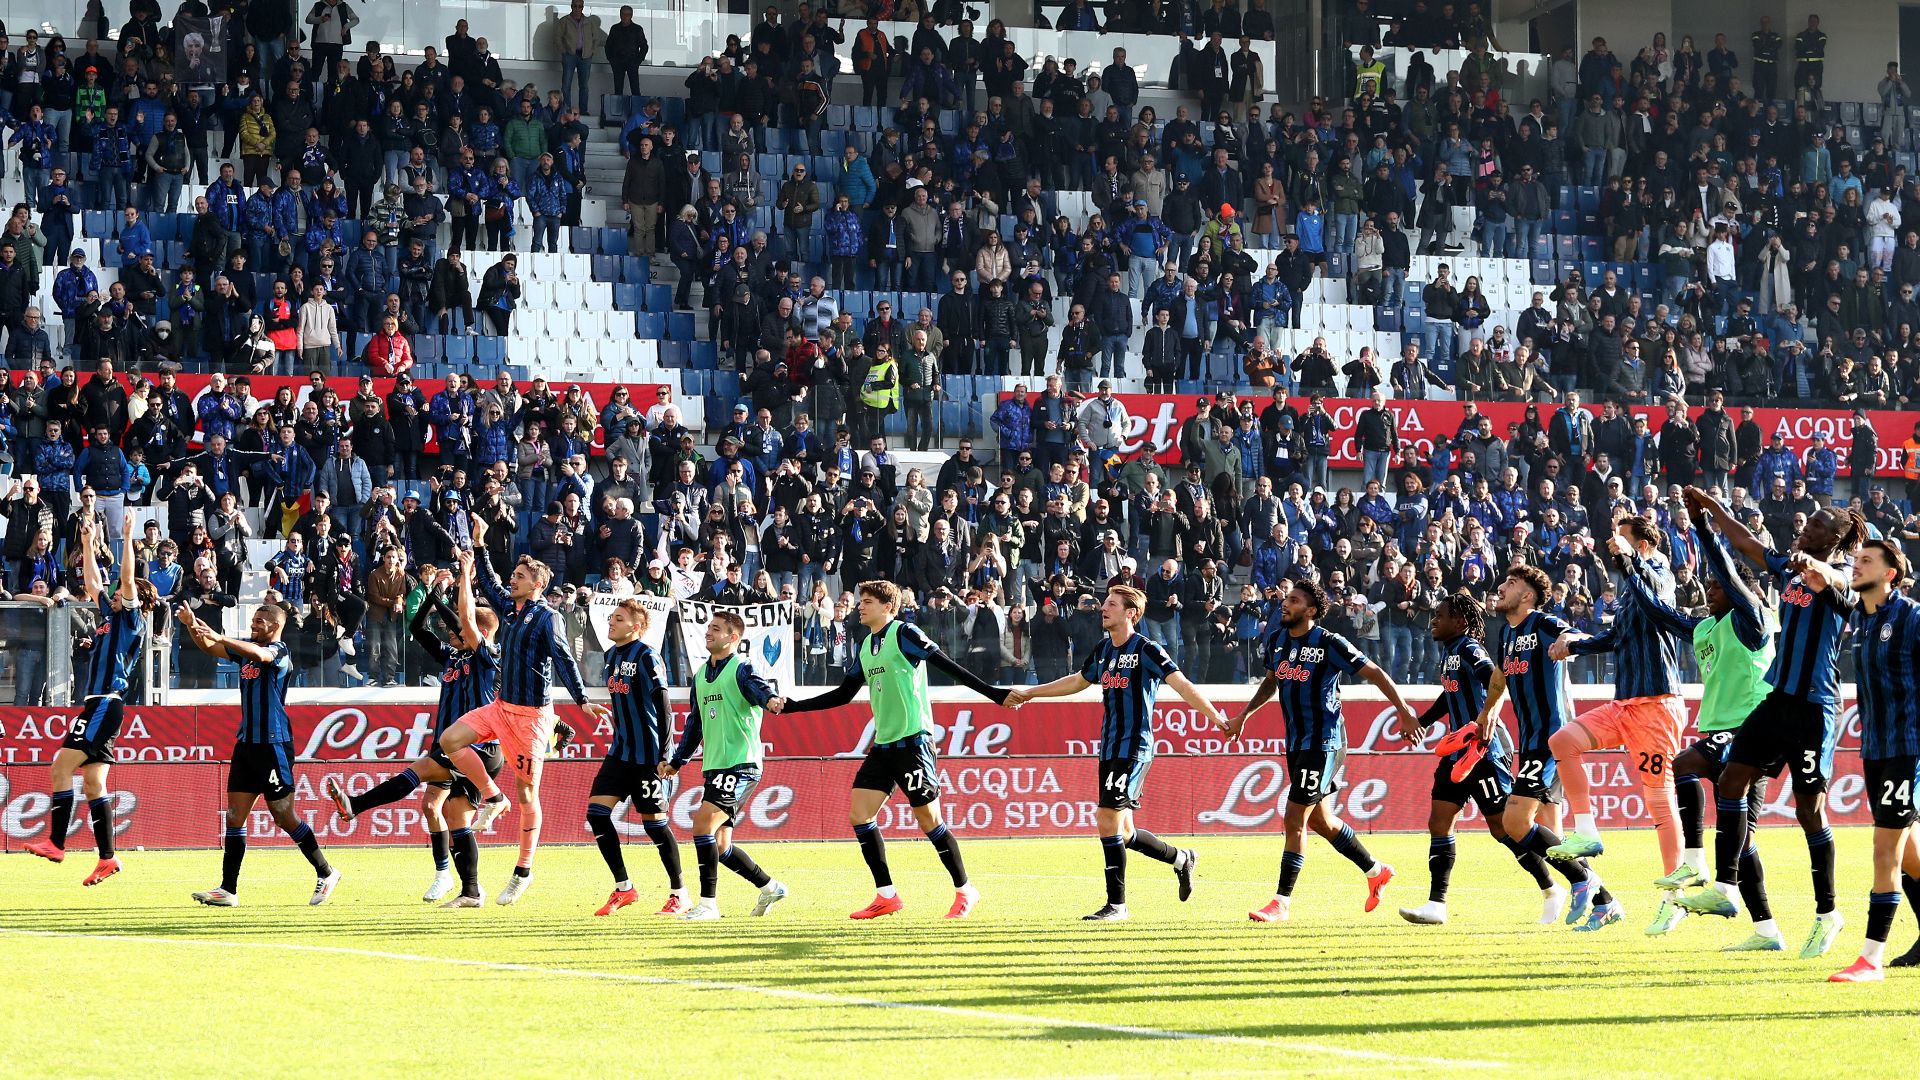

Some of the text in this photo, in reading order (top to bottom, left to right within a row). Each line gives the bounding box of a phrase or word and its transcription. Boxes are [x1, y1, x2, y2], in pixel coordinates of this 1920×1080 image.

[1076, 398, 1186, 455] et
[1334, 406, 1424, 431] CUA
[1515, 640, 1538, 651] GROUP
[1274, 660, 1310, 682] Lete
[15, 714, 151, 740] ACA
[69, 718, 87, 736] 15
[295, 708, 434, 760] Let
[1151, 708, 1229, 737] CQU
[113, 746, 214, 761] PORT
[516, 754, 532, 775] 31
[1638, 751, 1664, 775] 28
[1802, 750, 1817, 774] 3
[268, 769, 280, 785] 4
[904, 768, 925, 791] 27
[1104, 771, 1128, 793] 44
[1299, 769, 1320, 790] 13
[1517, 759, 1543, 781] 22
[641, 780, 662, 799] 32
[711, 773, 737, 792] 48
[937, 767, 1062, 800] ACQUA
[1197, 759, 1388, 827] Lte
[1478, 776, 1500, 799] 11
[1881, 780, 1911, 806] 24
[0, 772, 139, 839] ete
[585, 770, 796, 839] ee
[876, 801, 1098, 830] DELO SPOR
[217, 809, 358, 837] ELO
